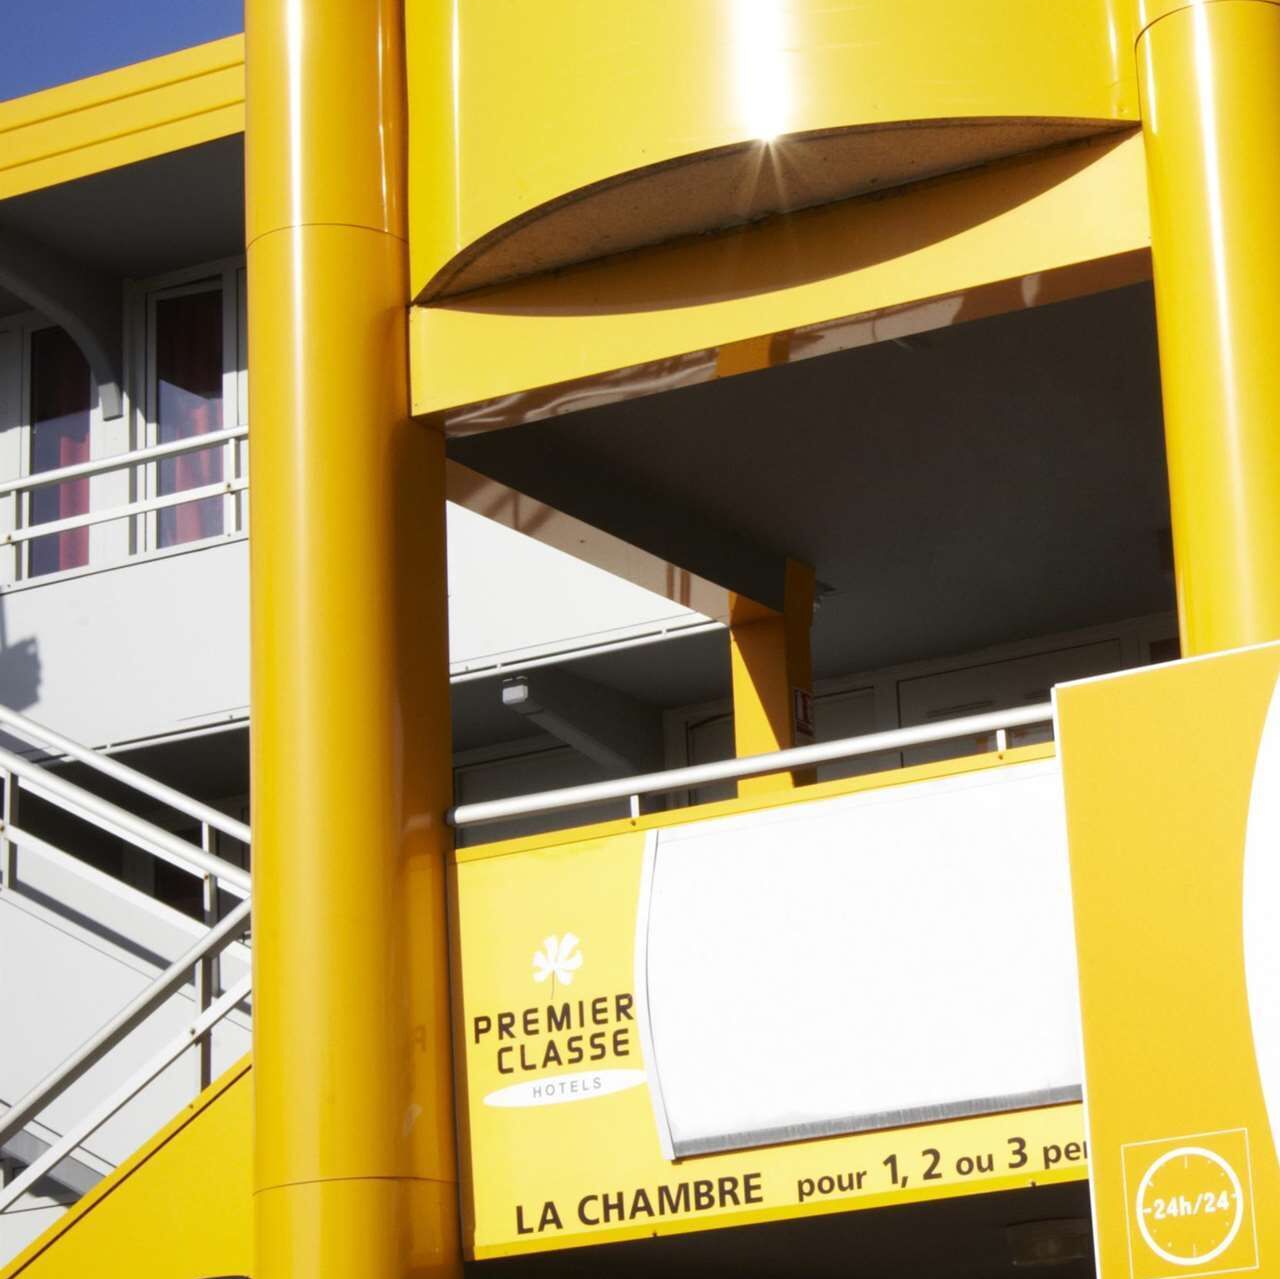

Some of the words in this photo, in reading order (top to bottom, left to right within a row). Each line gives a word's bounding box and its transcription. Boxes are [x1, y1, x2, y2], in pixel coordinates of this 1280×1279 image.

[496, 1028, 631, 1075] CLASSE
[532, 1076, 603, 1099] HOTELS
[516, 1201, 564, 1235] LA
[577, 1173, 763, 1227] CHAMBRE
[796, 1168, 868, 1203] pour
[882, 1153, 909, 1188] 1,
[920, 1147, 943, 1180] 2
[955, 1145, 995, 1175] ou
[1006, 1136, 1028, 1168] 3
[1152, 1189, 1230, 1220] 24h/24
